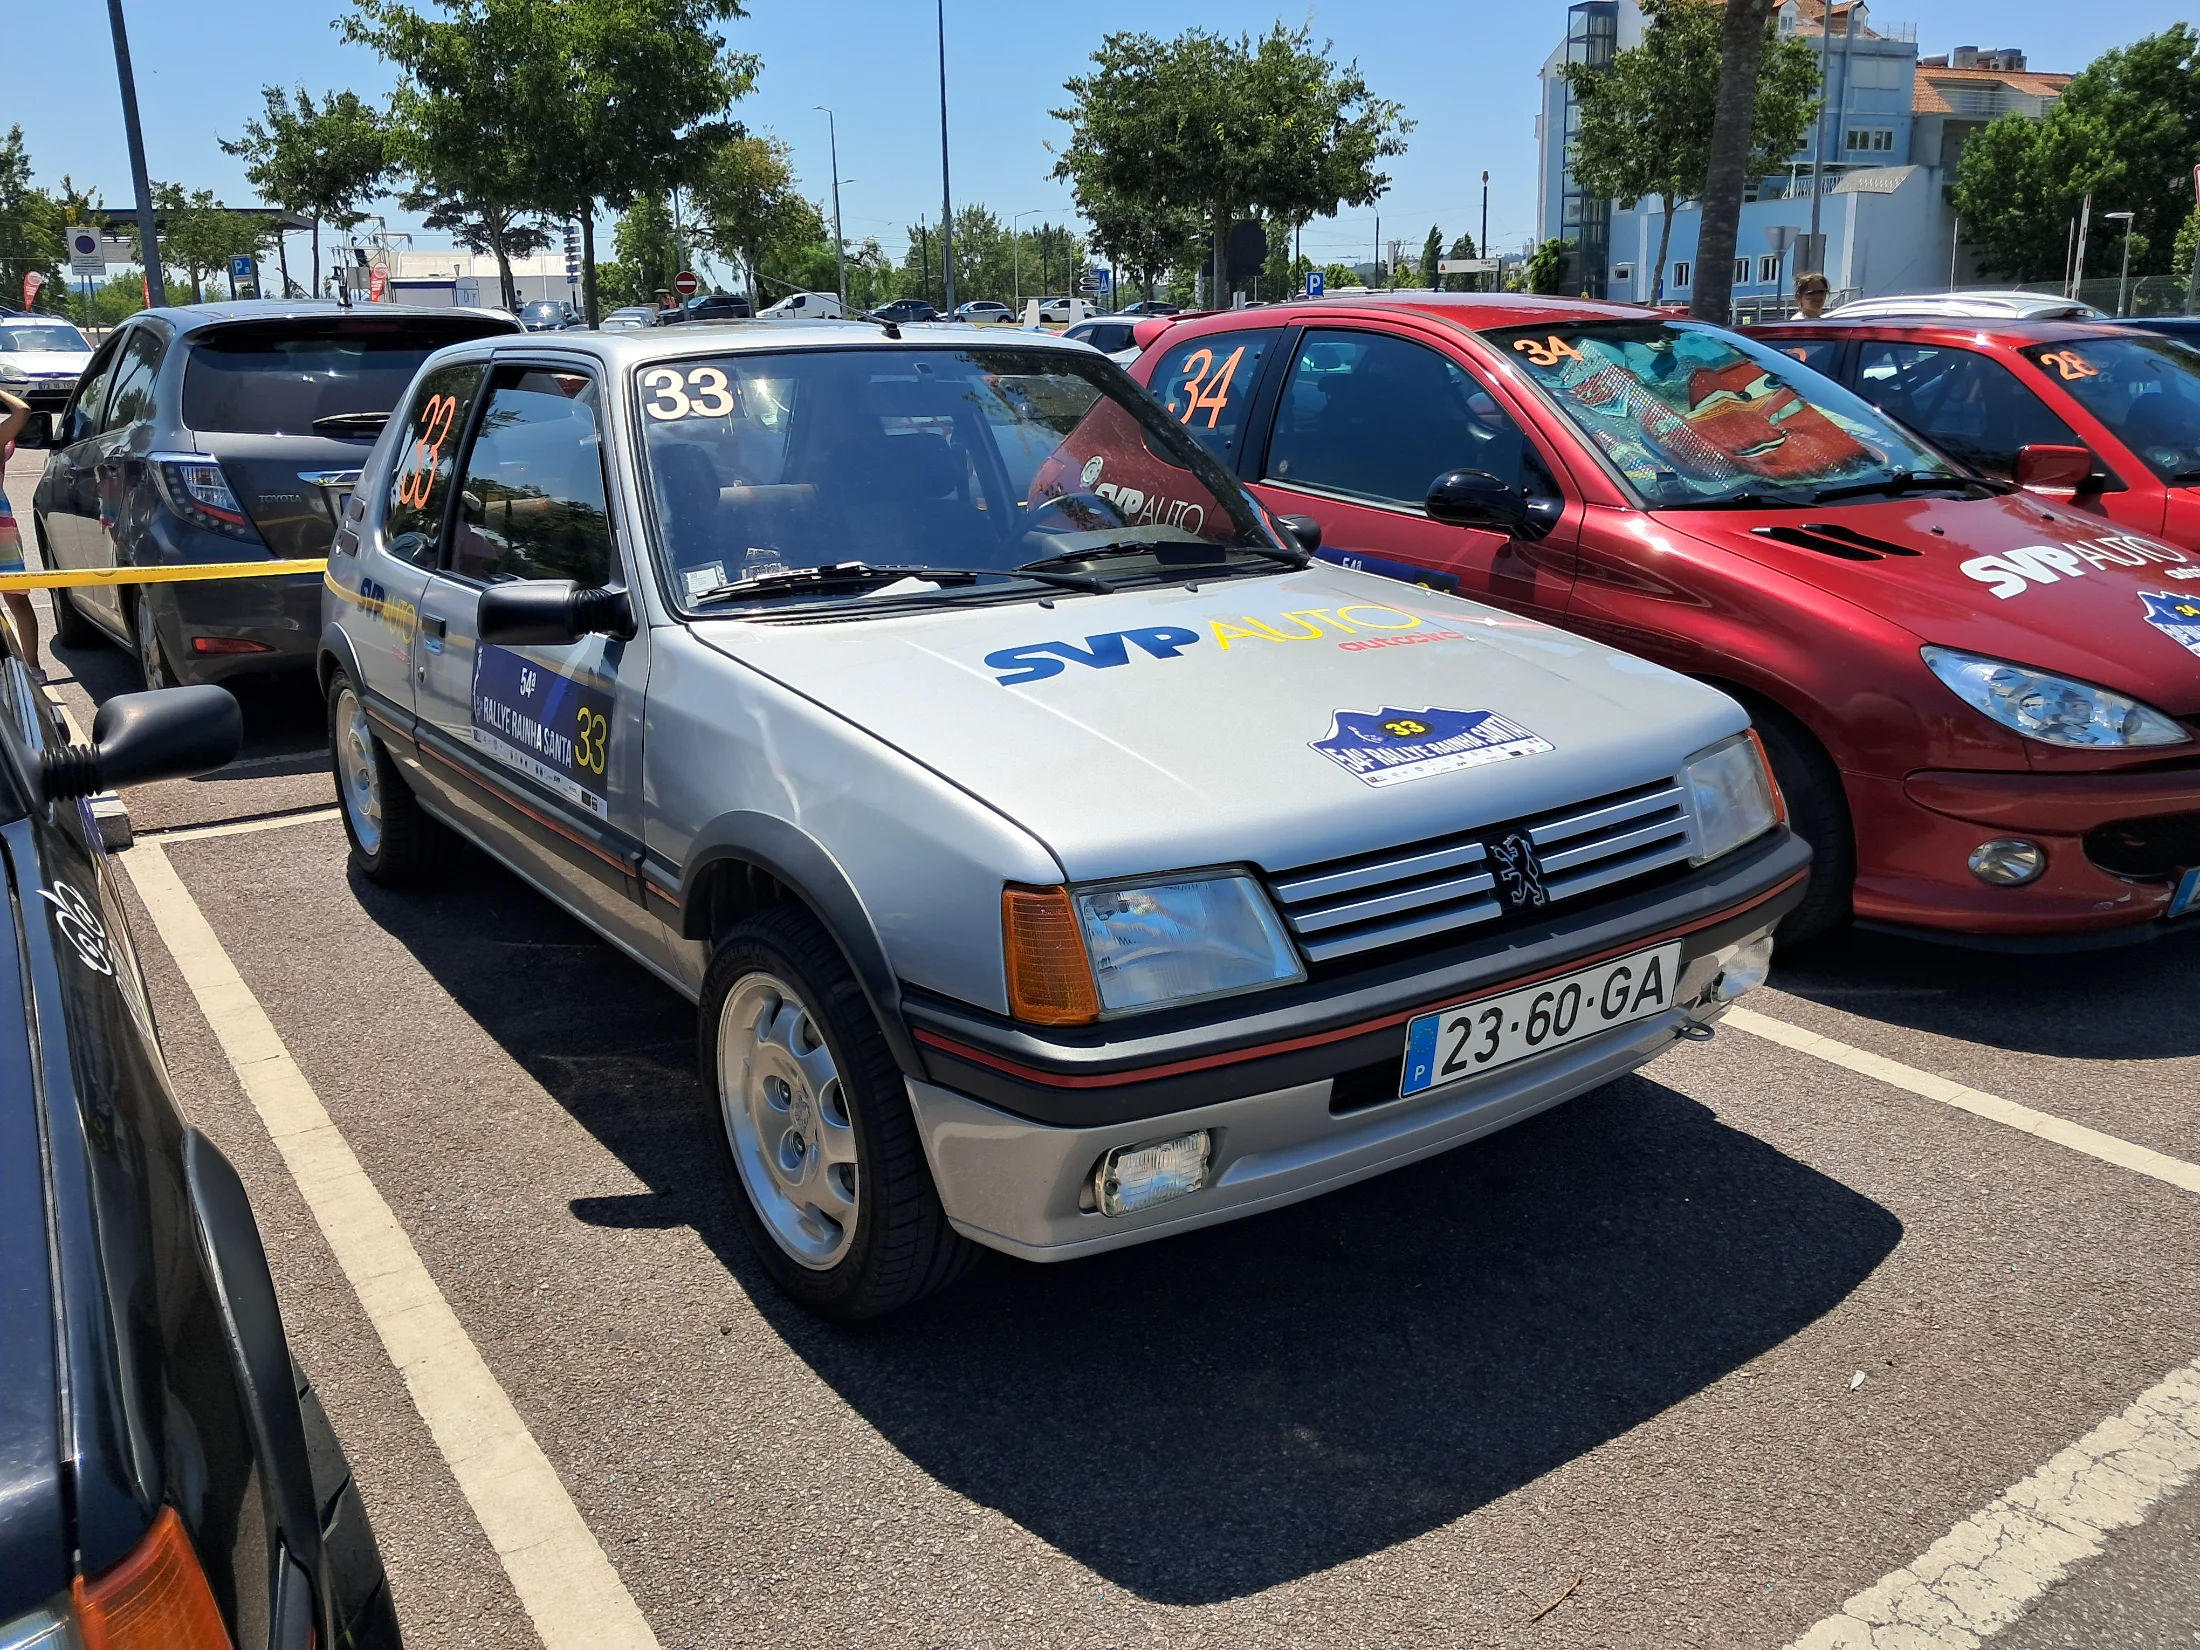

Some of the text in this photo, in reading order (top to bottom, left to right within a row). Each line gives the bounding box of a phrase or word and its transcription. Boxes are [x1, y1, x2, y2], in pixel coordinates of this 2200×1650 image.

[1309, 274, 1321, 294] P
[1512, 335, 1584, 366] 34
[2040, 350, 2099, 381] 28
[644, 367, 734, 420] 33
[1168, 346, 1246, 429] 34
[401, 393, 456, 509] 33
[258, 493, 302, 503] TOYOTA
[983, 605, 1422, 688] SVP AUTO
[483, 696, 511, 735] RALLYE
[511, 710, 542, 752] RAINHA
[543, 727, 572, 769] SANTA
[574, 706, 607, 775] 33
[1365, 745, 1435, 766] RALLYE
[1427, 732, 1484, 755] RAINHA
[1471, 714, 1533, 744] SANTA
[1385, 720, 1426, 736] 33
[1413, 1064, 1426, 1082] P
